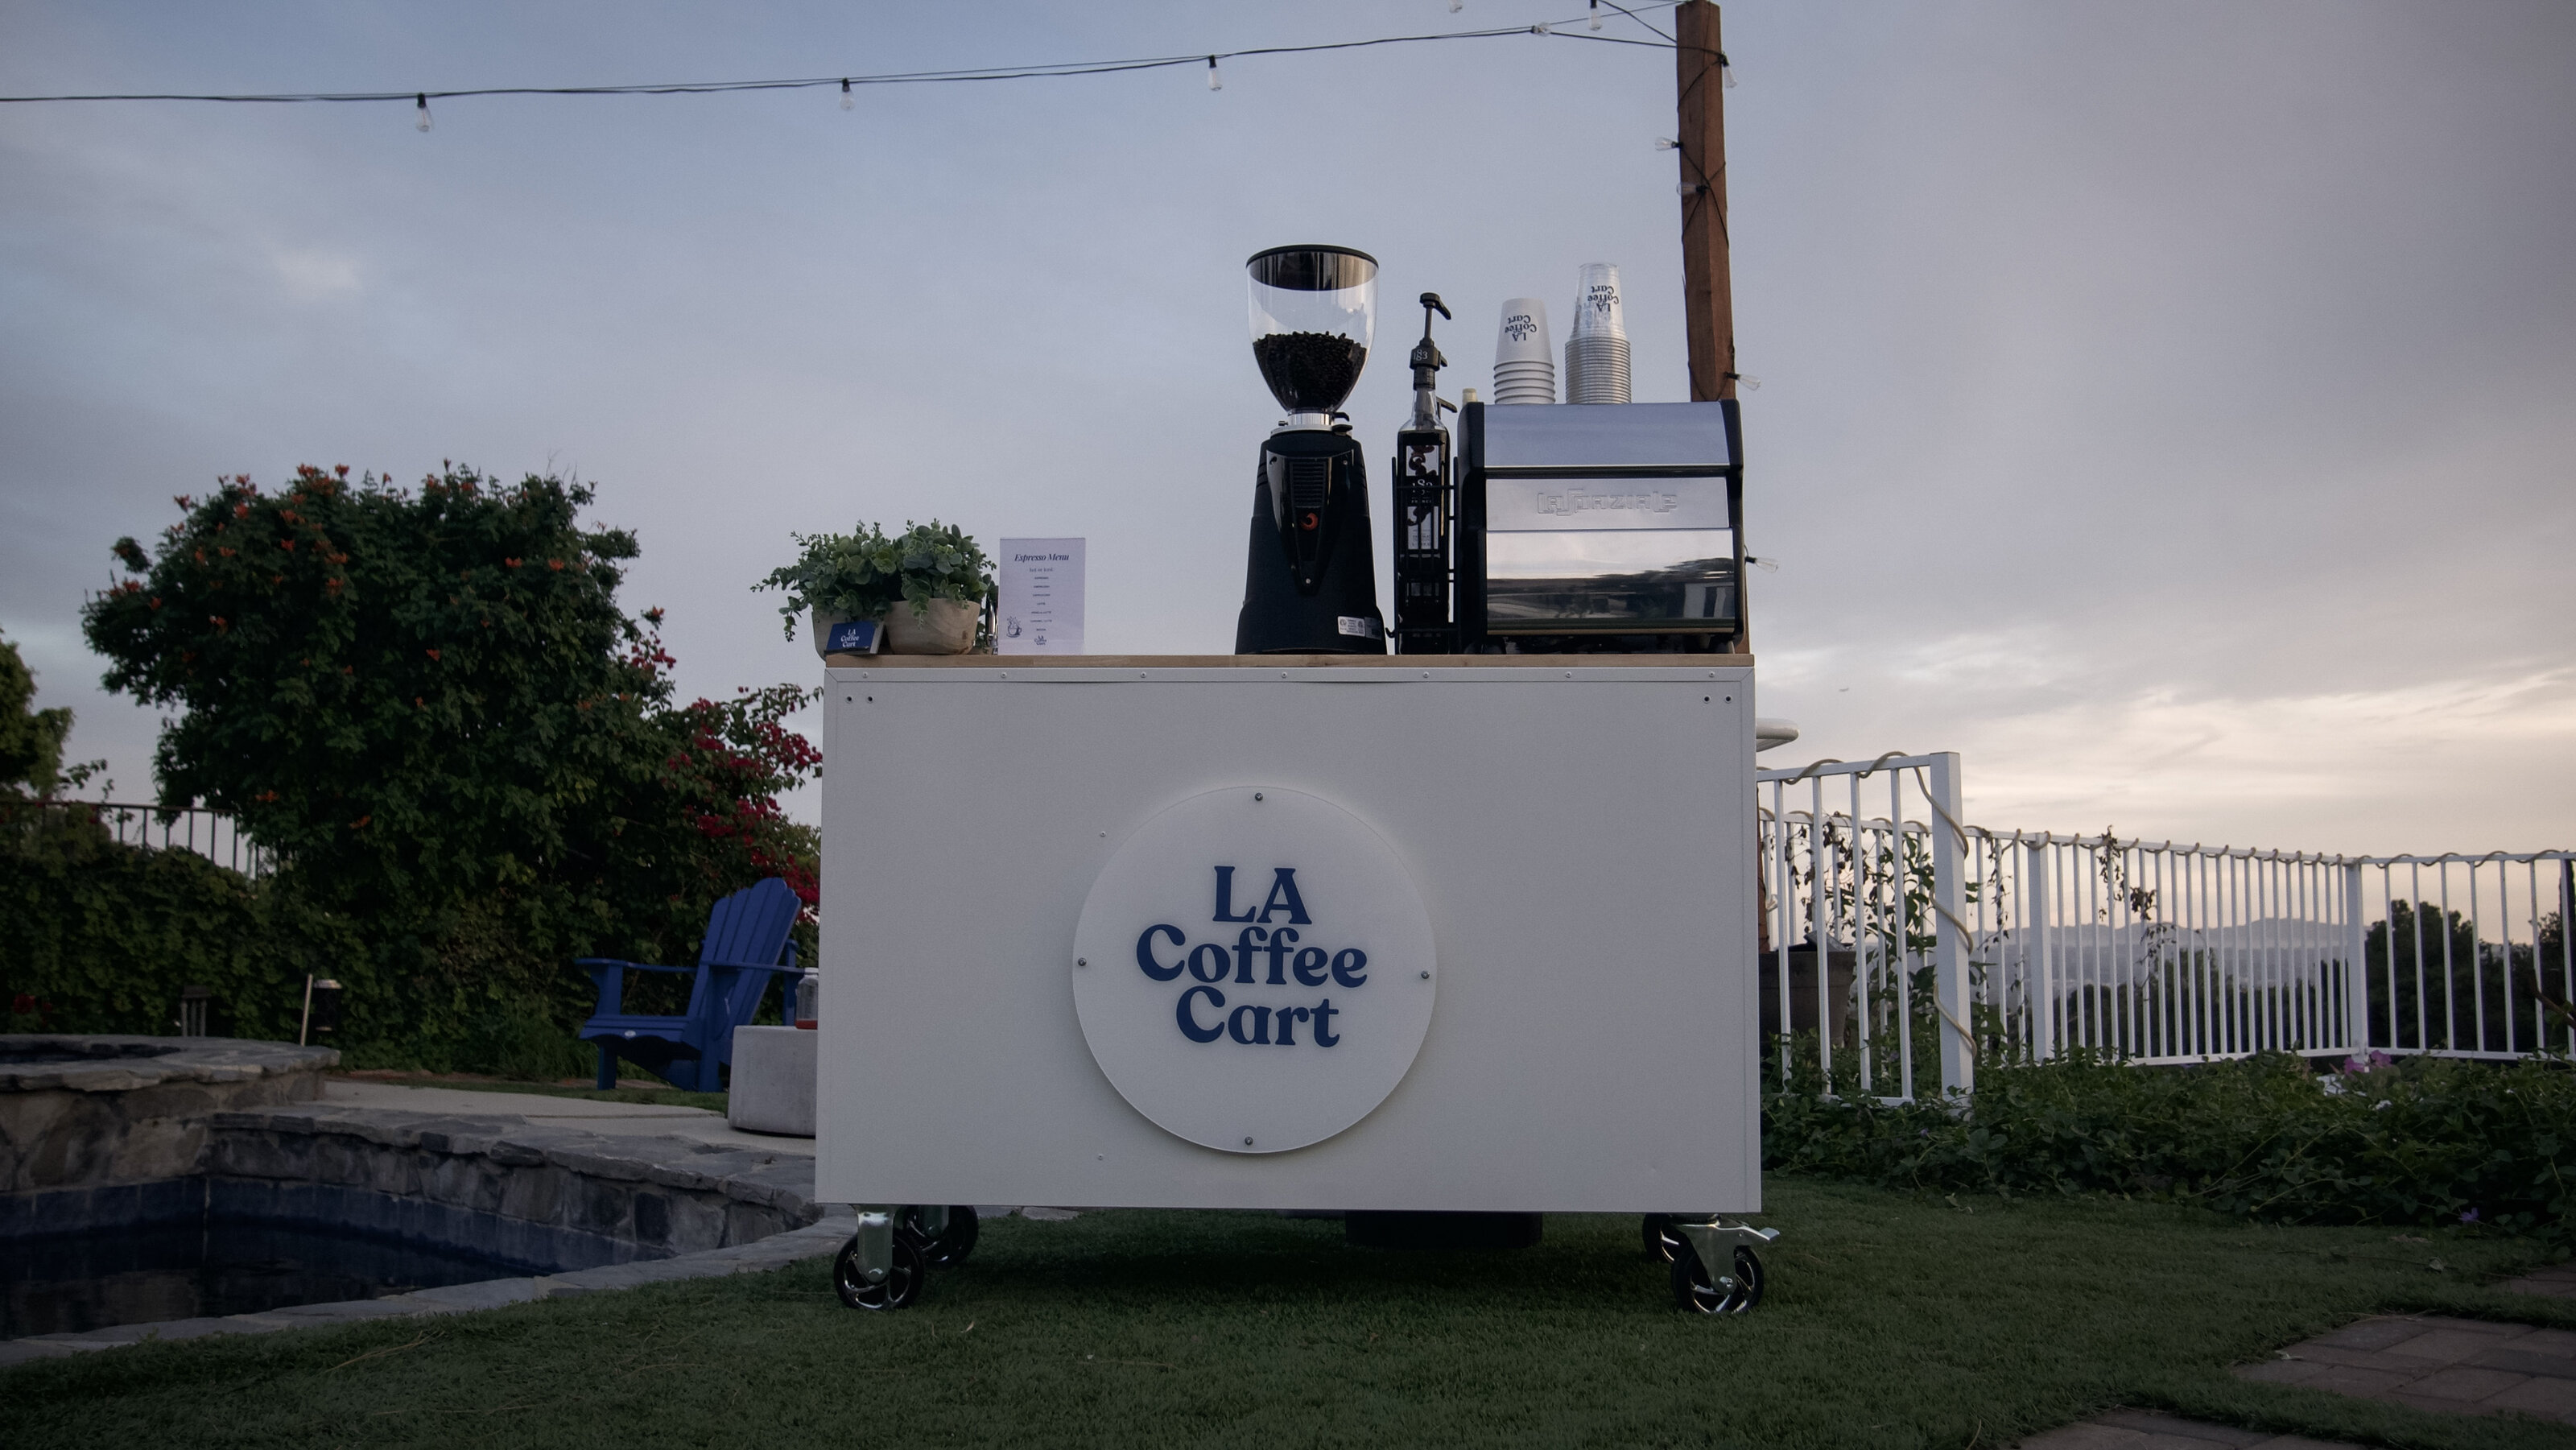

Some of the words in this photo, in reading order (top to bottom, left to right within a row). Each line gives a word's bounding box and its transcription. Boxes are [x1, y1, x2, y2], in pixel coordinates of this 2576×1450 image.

[1591, 285, 1615, 294] Cart
[1587, 293, 1619, 305] Coffee
[1596, 302, 1611, 312] LA
[1508, 315, 1531, 324] Cart
[1505, 323, 1538, 334] Coffee
[1512, 332, 1527, 342] LA
[1014, 553, 1046, 563] Espresso
[1048, 553, 1070, 561] Menu
[1212, 865, 1313, 925] LA
[1136, 923, 1368, 989] Coffee
[1176, 985, 1340, 1047] Cart
